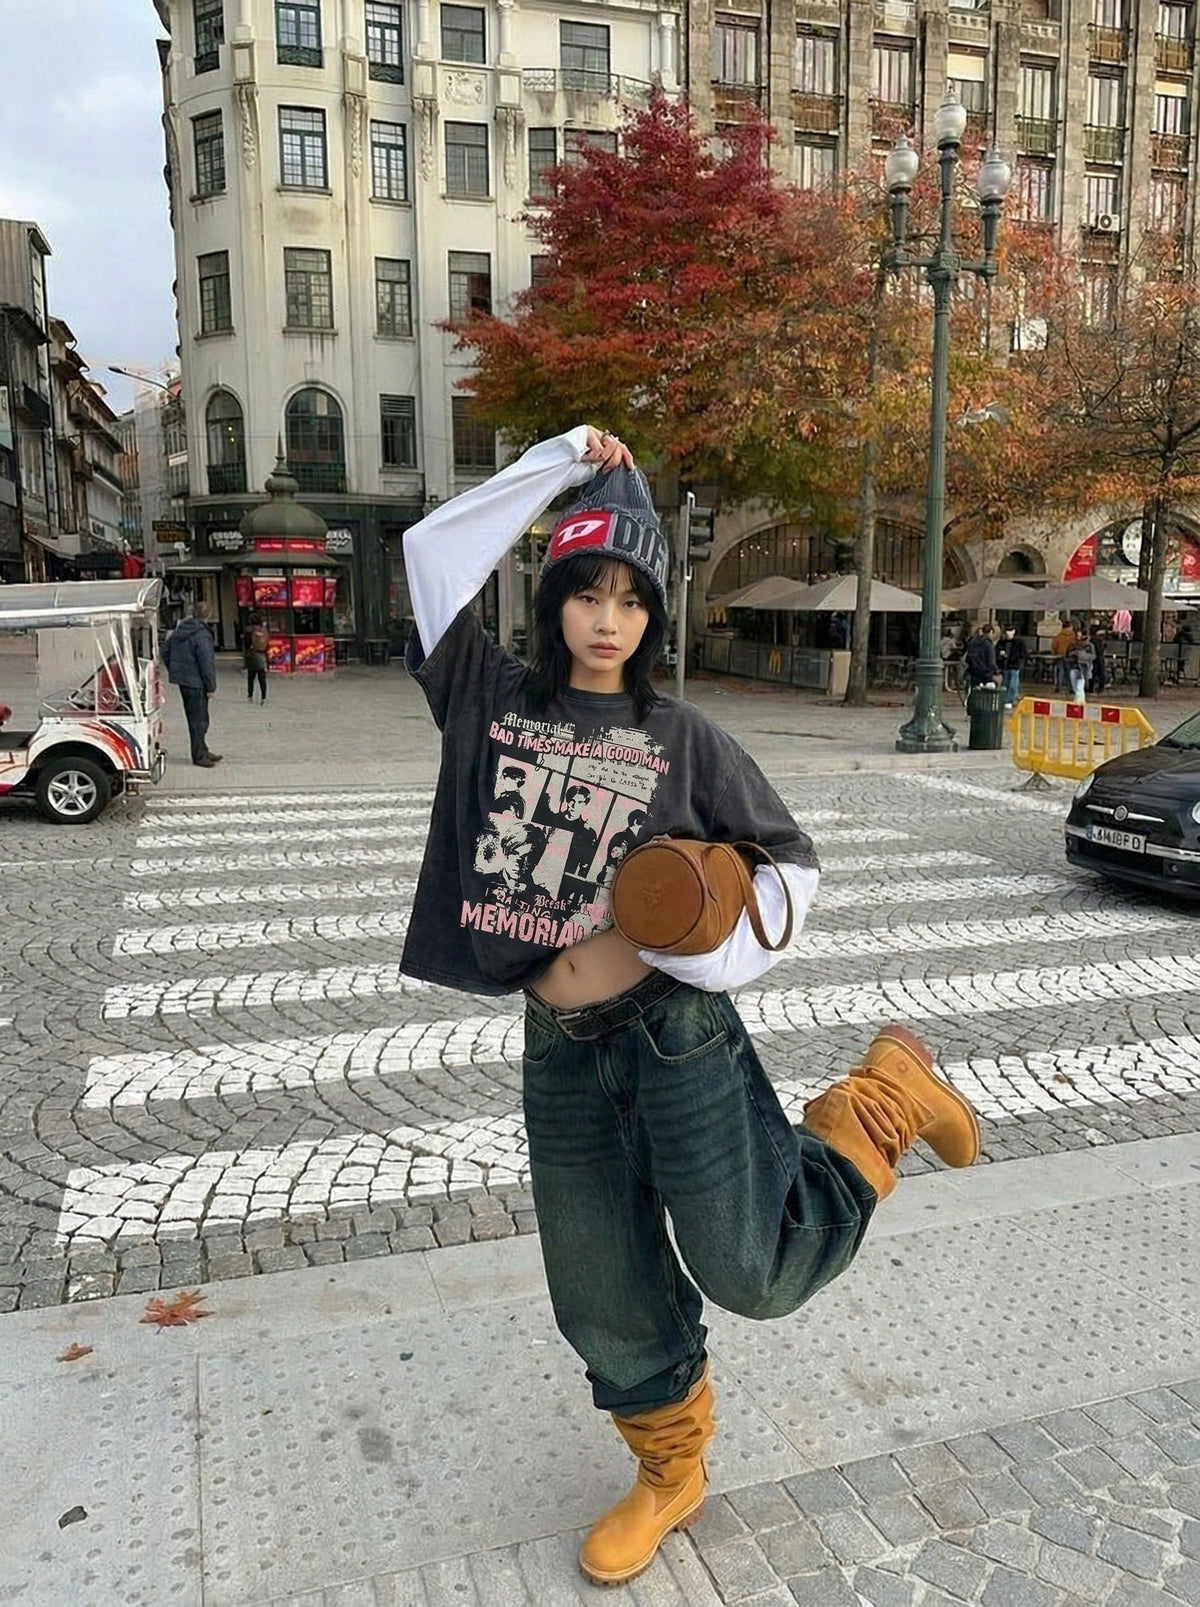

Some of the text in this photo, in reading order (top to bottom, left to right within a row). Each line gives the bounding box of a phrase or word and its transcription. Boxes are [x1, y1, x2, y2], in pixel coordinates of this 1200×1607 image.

[489, 720, 514, 746] BAD
[517, 734, 552, 753] TIMES
[554, 740, 591, 757] MAKE
[593, 743, 603, 758] A
[641, 750, 670, 776] MAN
